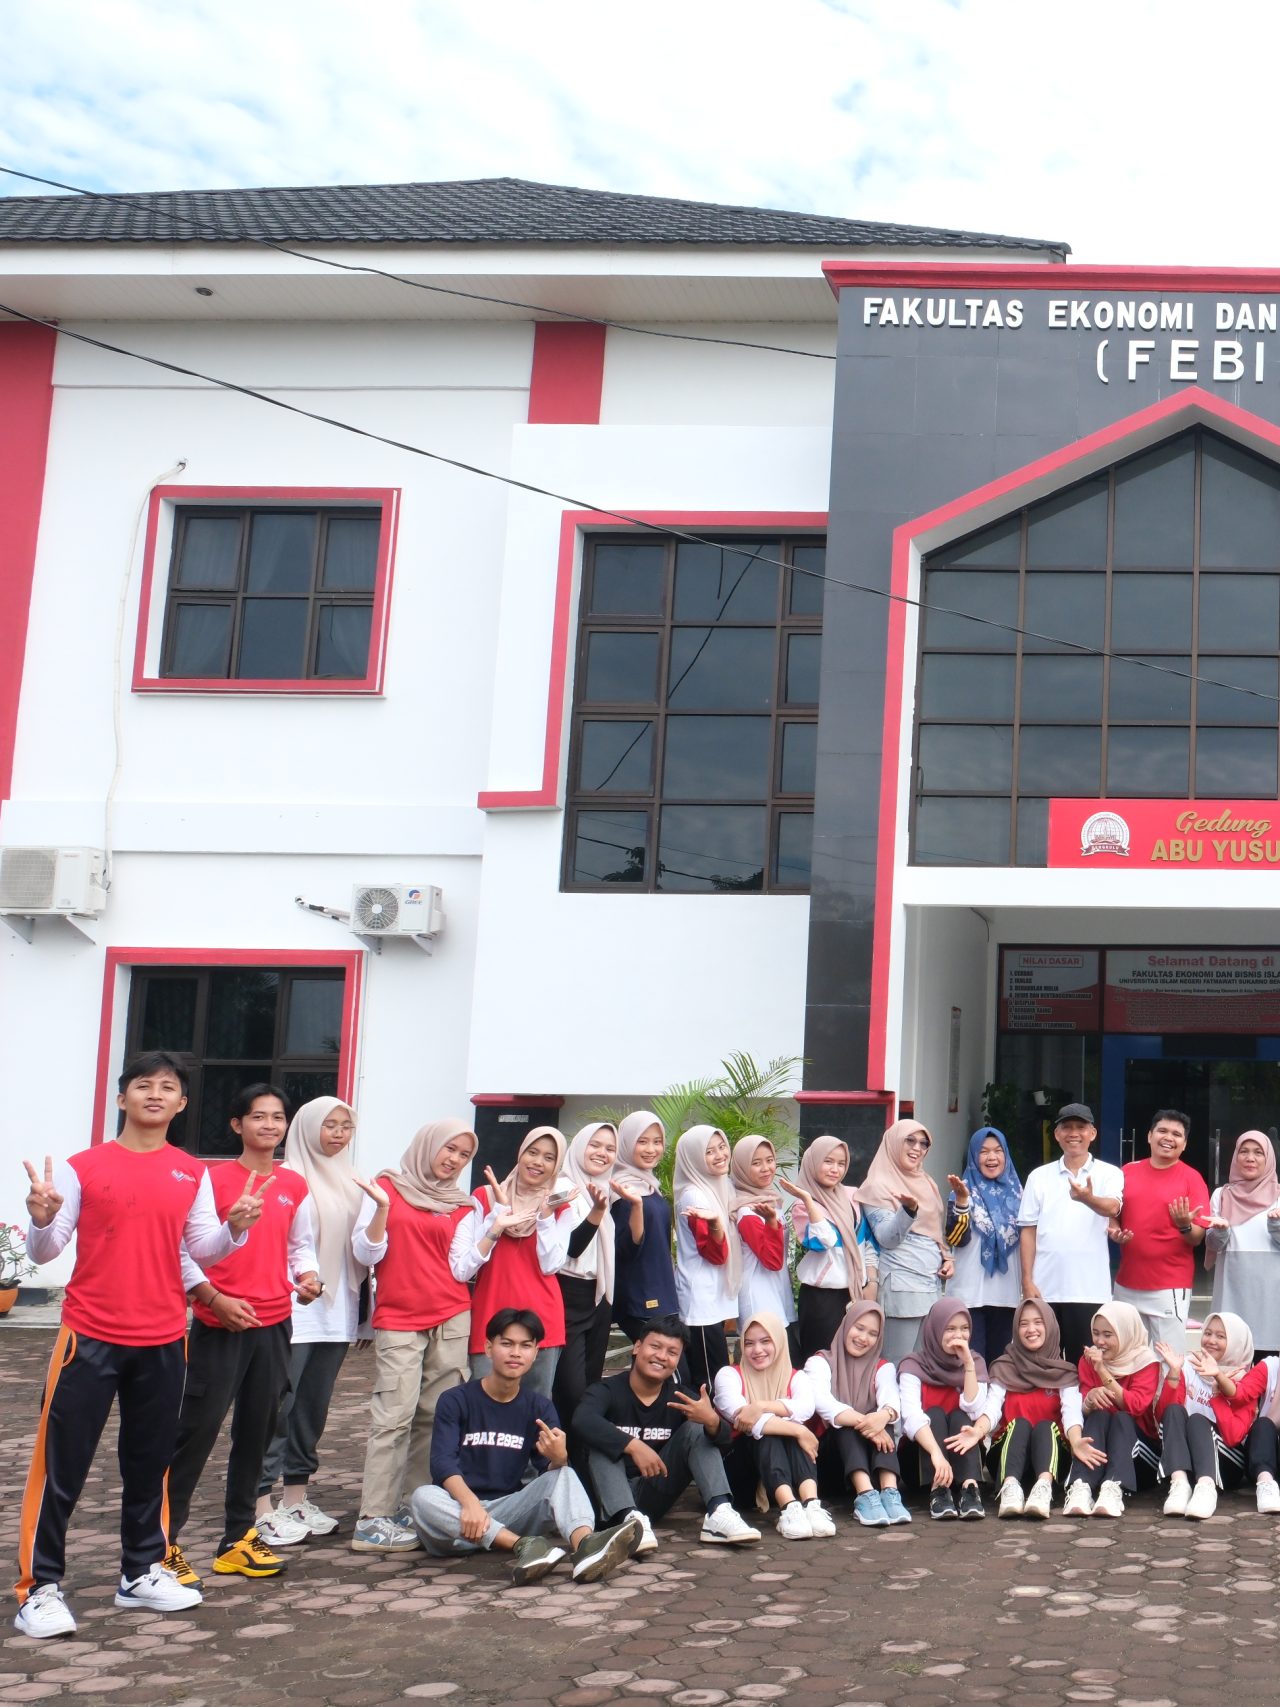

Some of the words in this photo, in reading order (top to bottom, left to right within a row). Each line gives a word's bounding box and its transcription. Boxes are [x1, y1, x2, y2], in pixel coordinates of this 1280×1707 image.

[863, 297, 1023, 329] FAKULTAS
[1048, 300, 1193, 330] EKONOMI
[1216, 302, 1277, 331] DAN
[1175, 808, 1272, 838] Gedung
[1150, 839, 1203, 861] ABU
[1023, 956, 1047, 965] NILAI
[1048, 956, 1080, 965] DASAR
[1148, 955, 1204, 966] Selamat
[1209, 955, 1257, 968] Datang
[1262, 956, 1274, 966] di
[1131, 970, 1173, 978] FAKULTAS
[1175, 970, 1213, 978] EKONOMI
[1215, 970, 1232, 978] DAN
[1234, 970, 1262, 978] BISNIS
[462, 1431, 496, 1446] PBAK
[496, 1432, 525, 1449] 2025
[643, 1427, 672, 1440] 2025
